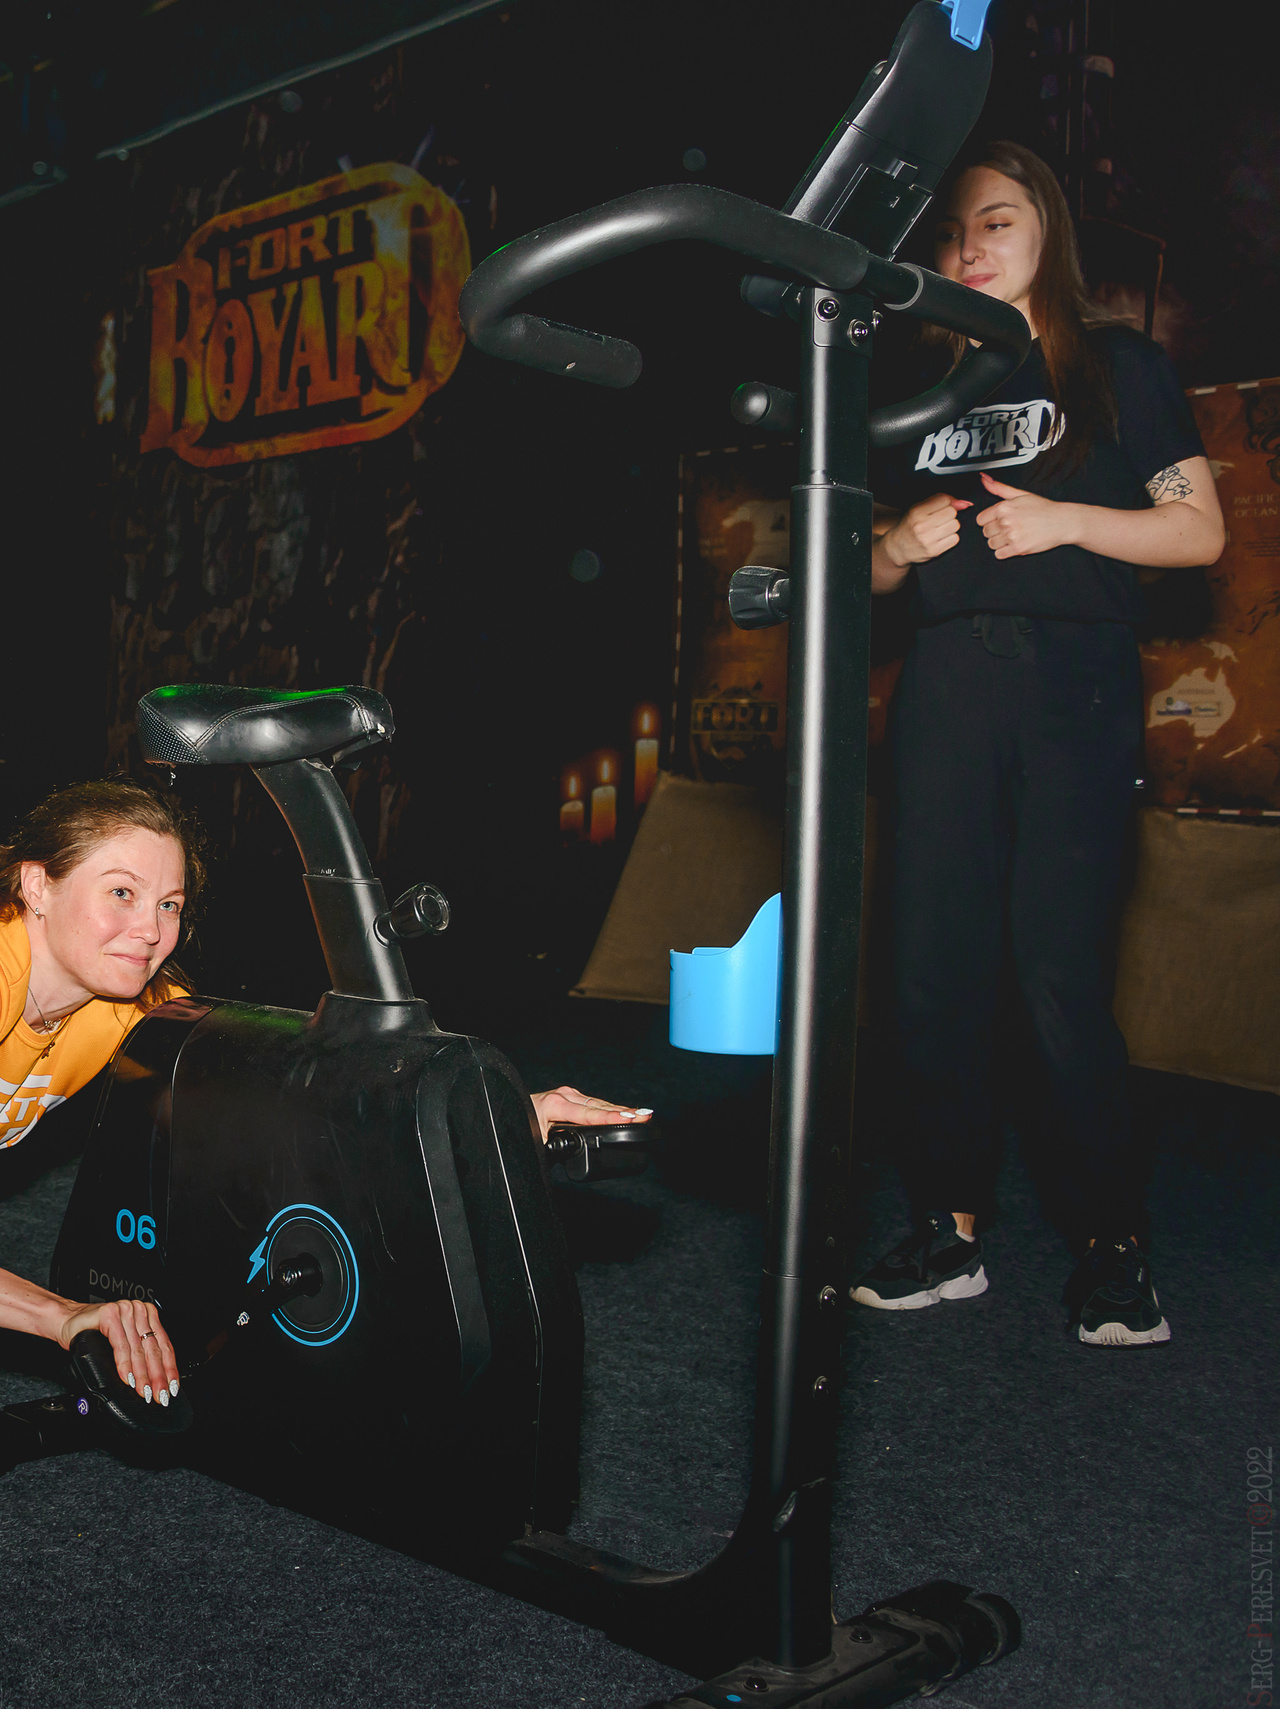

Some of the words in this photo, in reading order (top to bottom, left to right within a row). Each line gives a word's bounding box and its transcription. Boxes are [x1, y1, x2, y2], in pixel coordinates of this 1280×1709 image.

[217, 208, 368, 290] FORT
[140, 178, 472, 464] BOYARD
[915, 400, 1067, 475] BOYARD
[957, 408, 1025, 429] FORT
[115, 1208, 157, 1250] 06
[89, 1268, 154, 1303] DOMYOS
